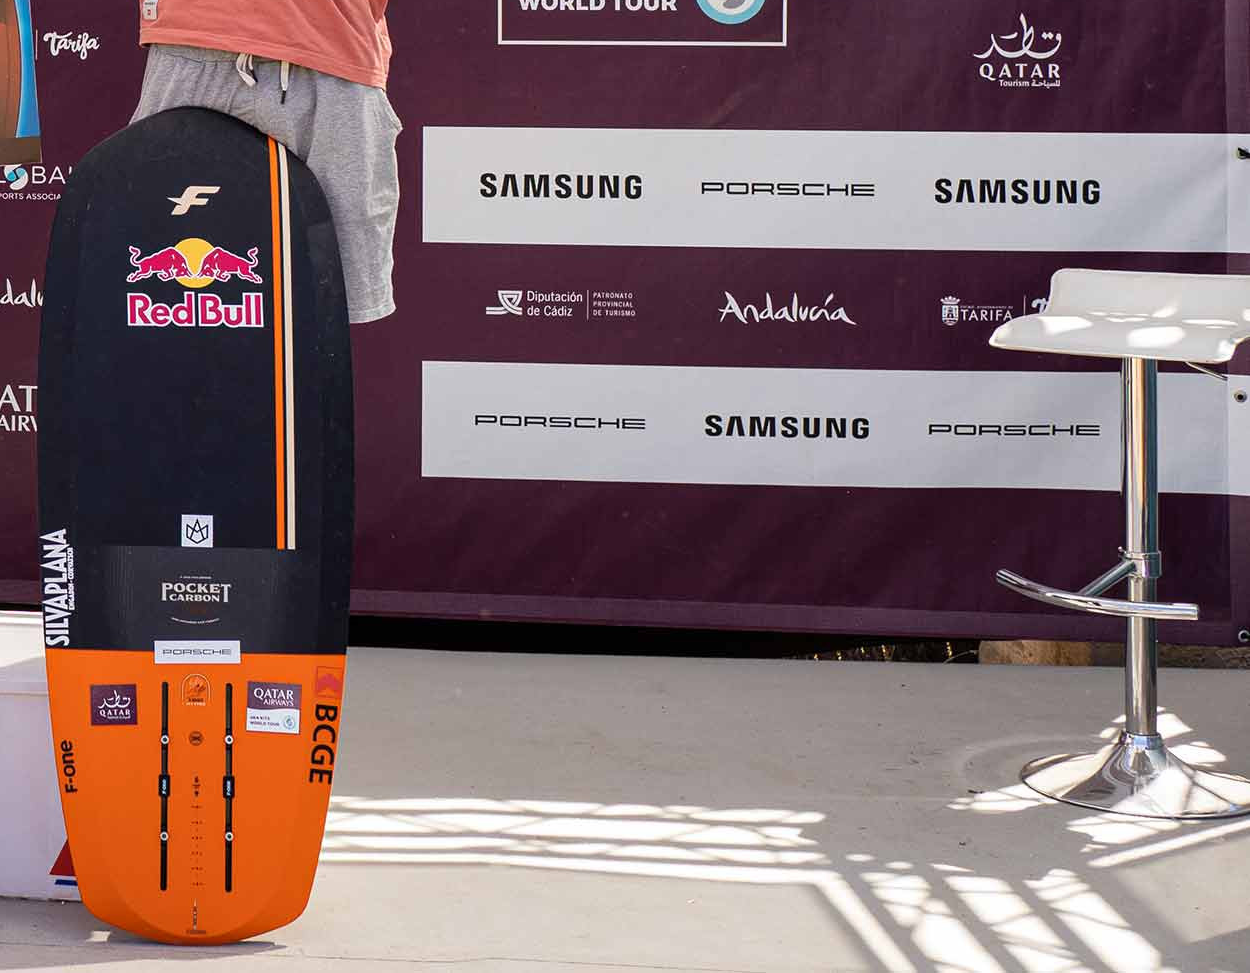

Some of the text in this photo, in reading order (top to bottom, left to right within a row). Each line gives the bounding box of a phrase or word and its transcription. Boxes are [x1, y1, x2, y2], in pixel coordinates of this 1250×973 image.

[43, 32, 99, 60] Tarifa
[980, 63, 1060, 81] QATAR
[480, 172, 1101, 204] SAMSUNG PORSCHE SAMSUNG
[527, 290, 583, 304] Diputación
[127, 292, 264, 328] Red Bull
[527, 304, 573, 317] de Cádiz
[718, 290, 857, 326] Andalucía
[961, 309, 1012, 321] TARIFA
[475, 414, 1101, 440] PORSCHE SAMSUNG PORSCHE
[40, 528, 72, 647] SILVAPLANA
[162, 582, 232, 602] POCKET
[169, 594, 219, 602] CARBON
[254, 688, 294, 700] QATAR
[263, 699, 294, 707] AIRWAYS
[100, 709, 131, 718] QATAR
[309, 704, 338, 785] BCGE
[60, 740, 78, 794] F-one
